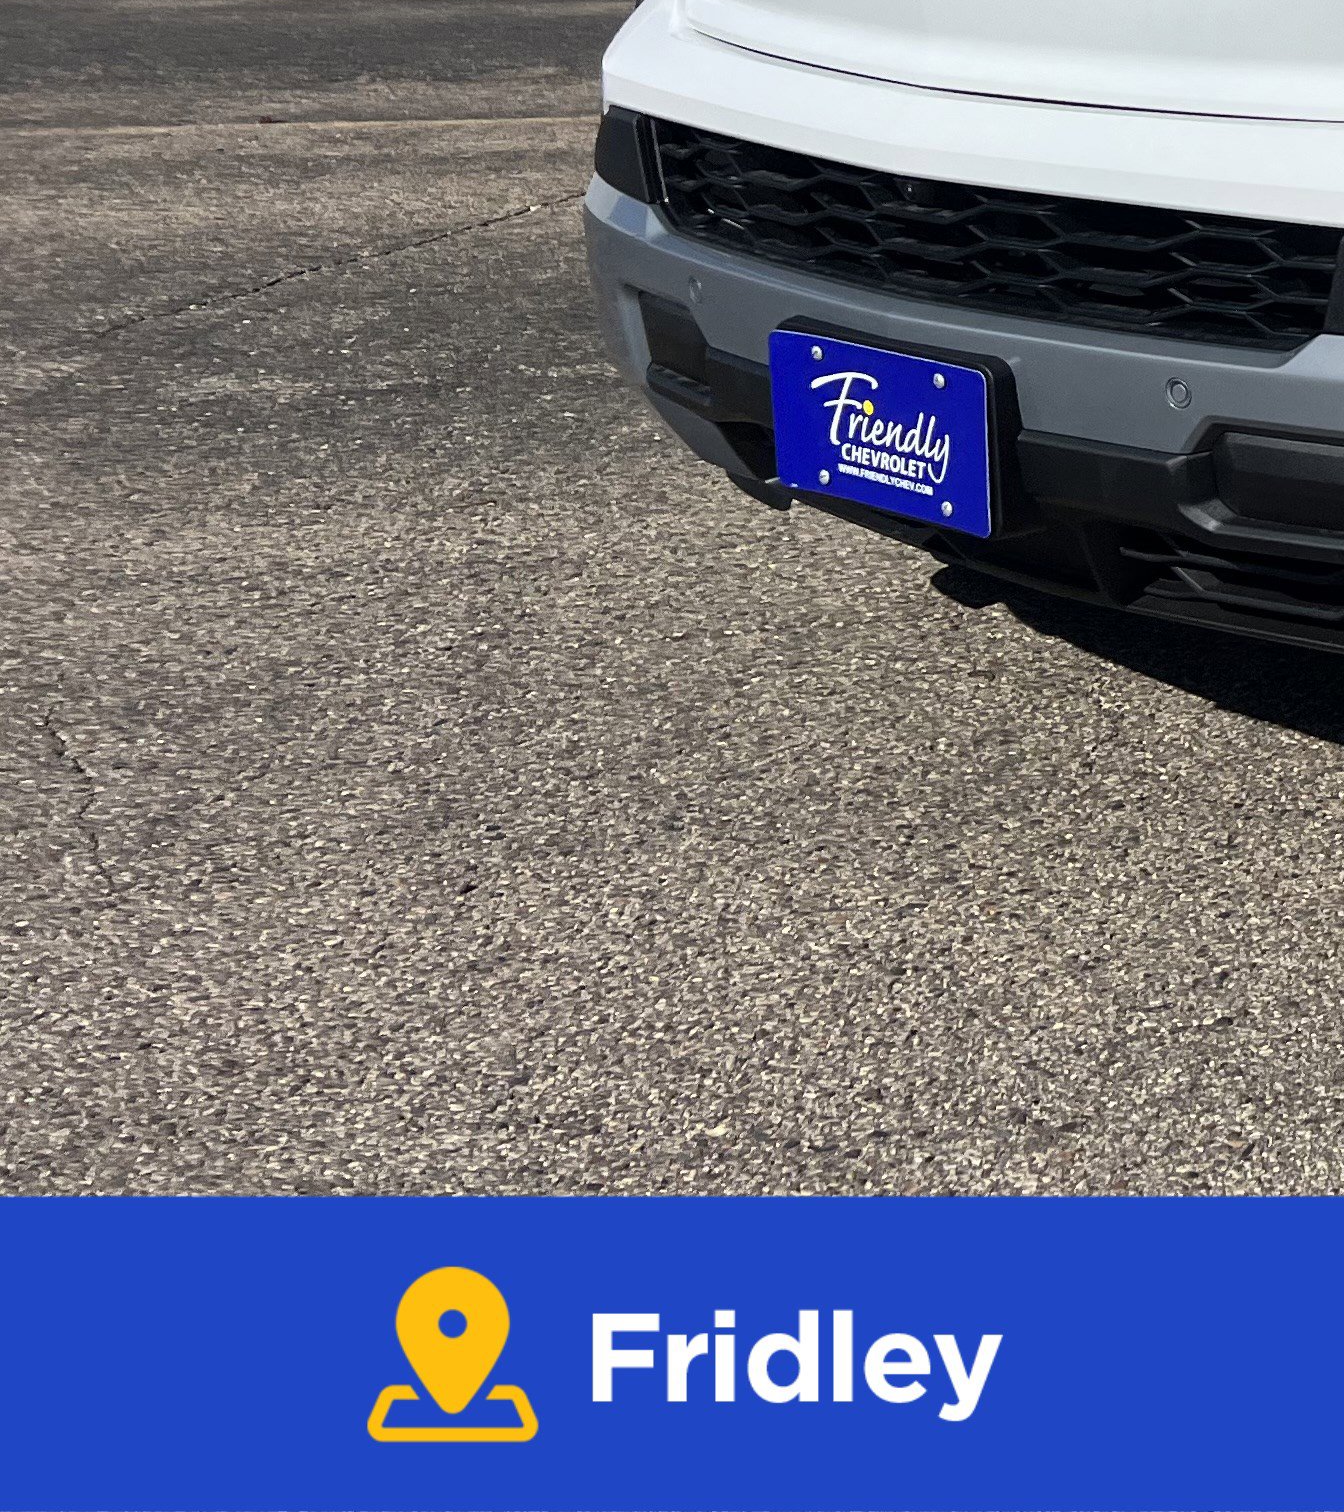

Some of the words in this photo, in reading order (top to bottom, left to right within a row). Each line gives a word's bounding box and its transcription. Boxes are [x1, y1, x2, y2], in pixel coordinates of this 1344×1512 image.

[811, 372, 949, 483] Friendly
[841, 443, 927, 479] CHEVROLET
[837, 463, 934, 496] WWW.FRIENDLYCHEV.COM
